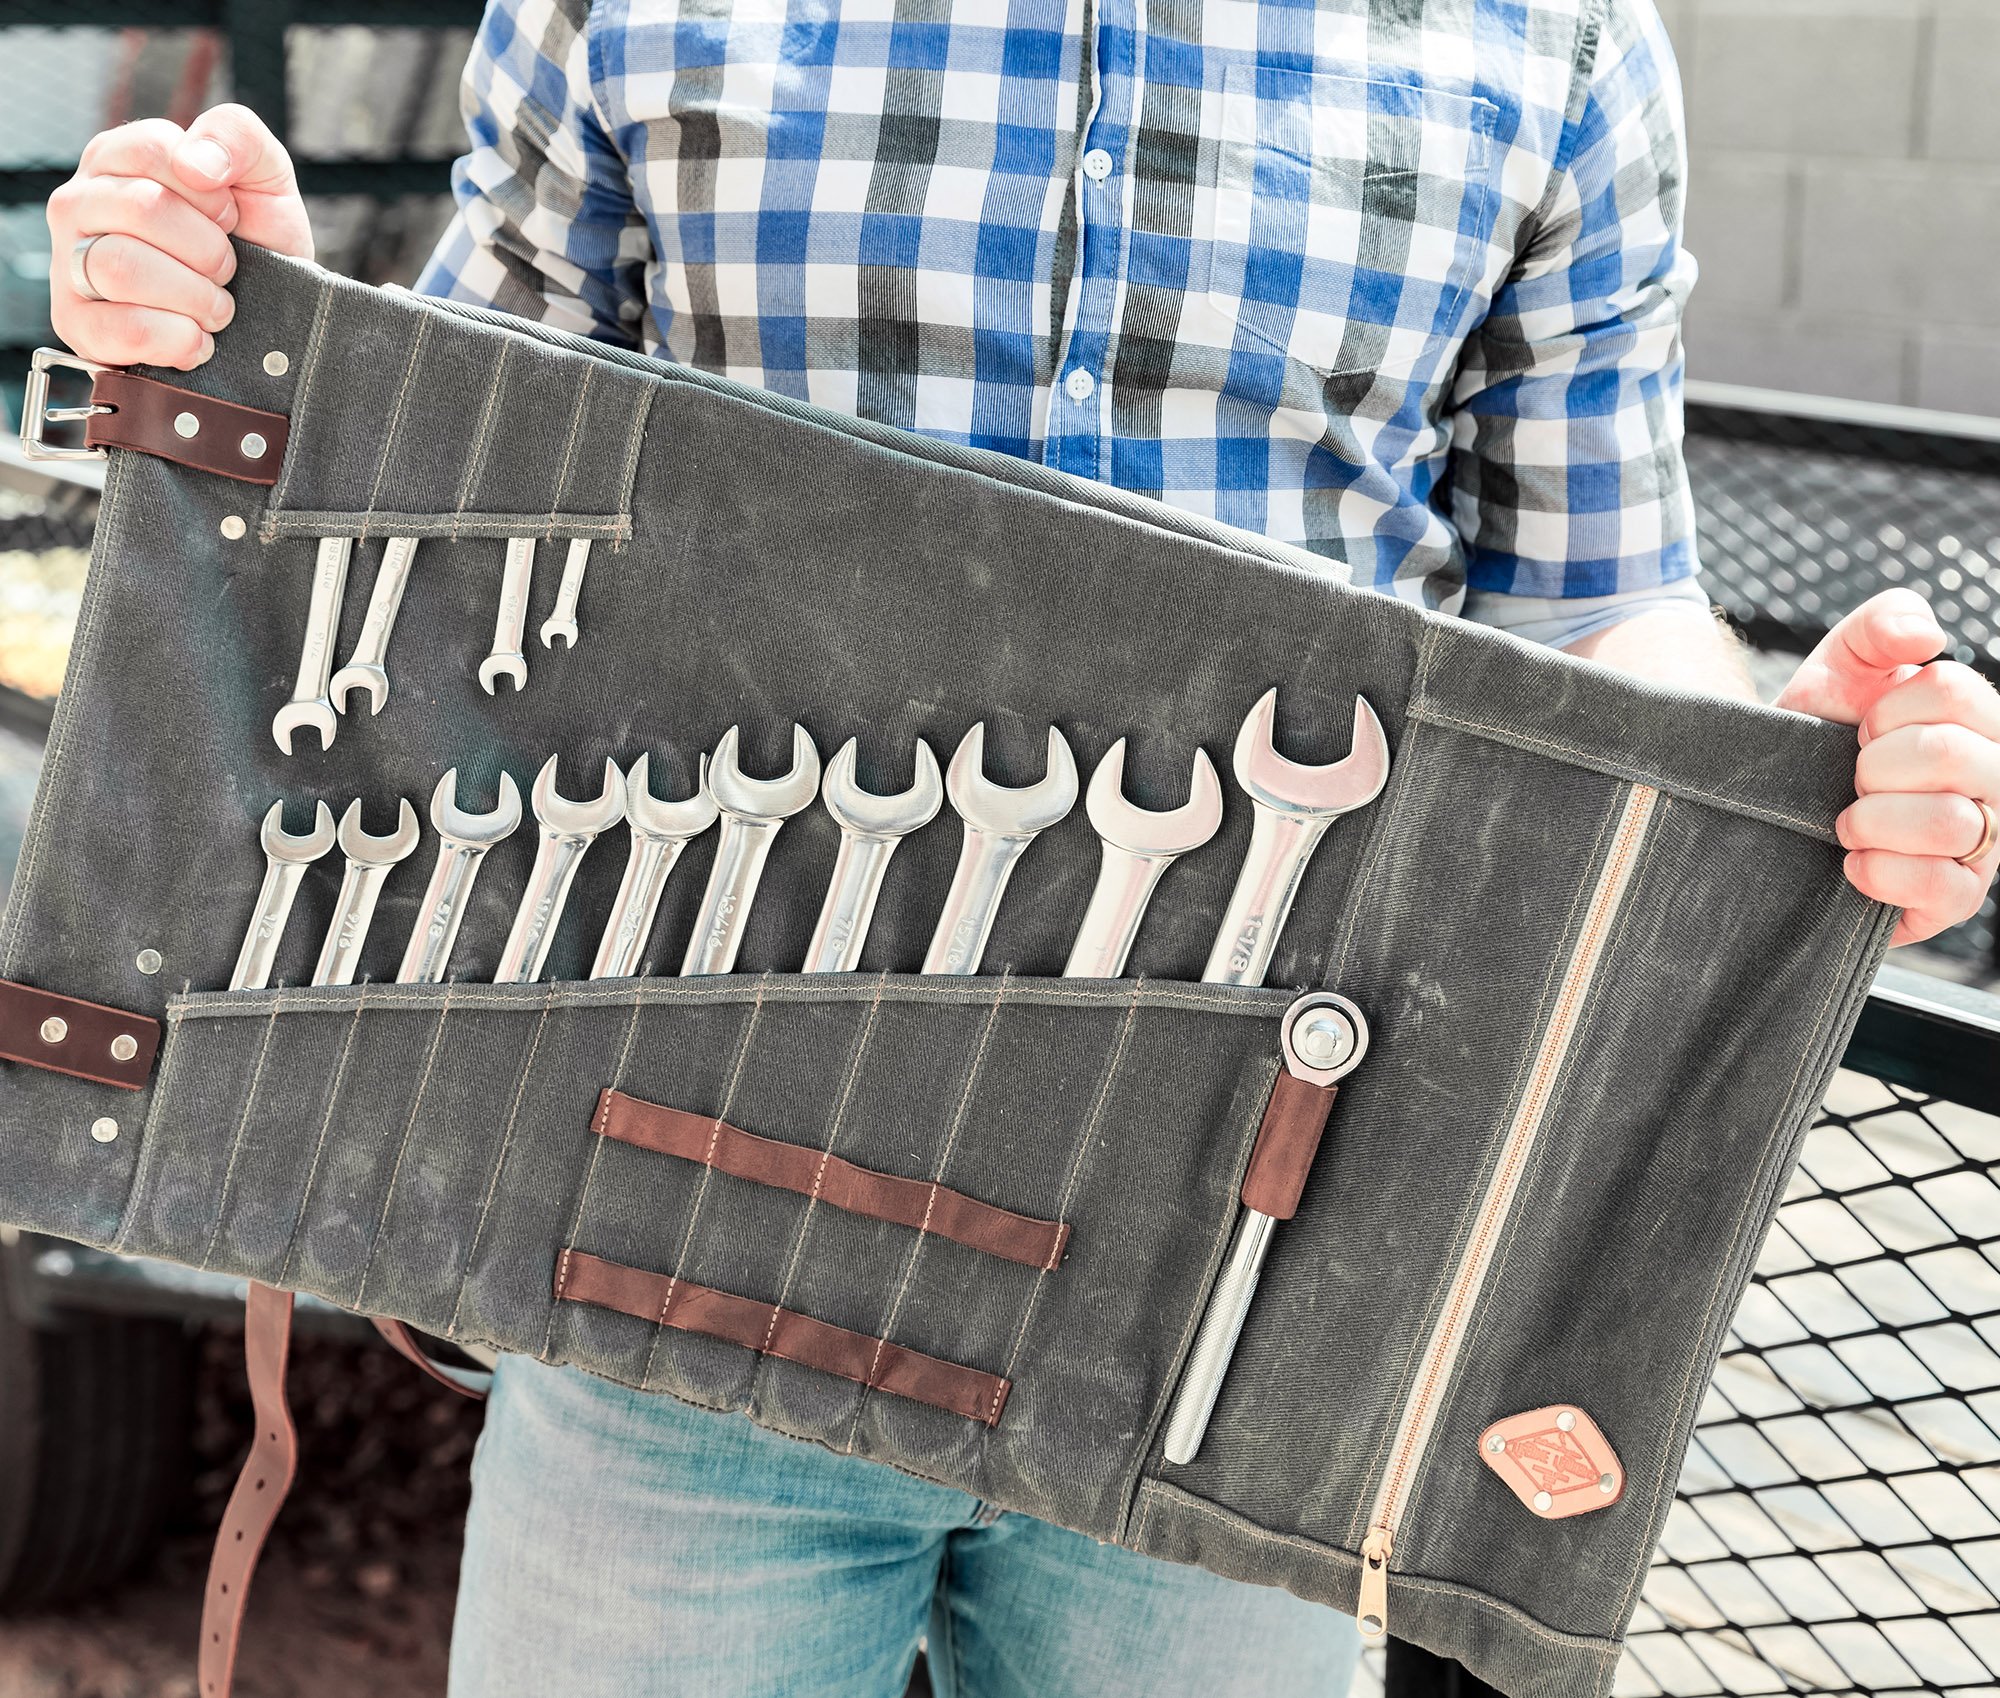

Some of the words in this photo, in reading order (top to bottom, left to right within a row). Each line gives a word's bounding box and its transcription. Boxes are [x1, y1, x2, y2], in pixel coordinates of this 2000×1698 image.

[257, 913, 277, 939] 1/2
[338, 912, 361, 949] 9/16
[428, 900, 451, 938] 5/8
[527, 897, 551, 938] 11/16
[709, 895, 737, 948] 13/16
[832, 917, 854, 951] 7/8
[947, 916, 976, 965] 15/16
[1230, 918, 1262, 973] 1-1/8
